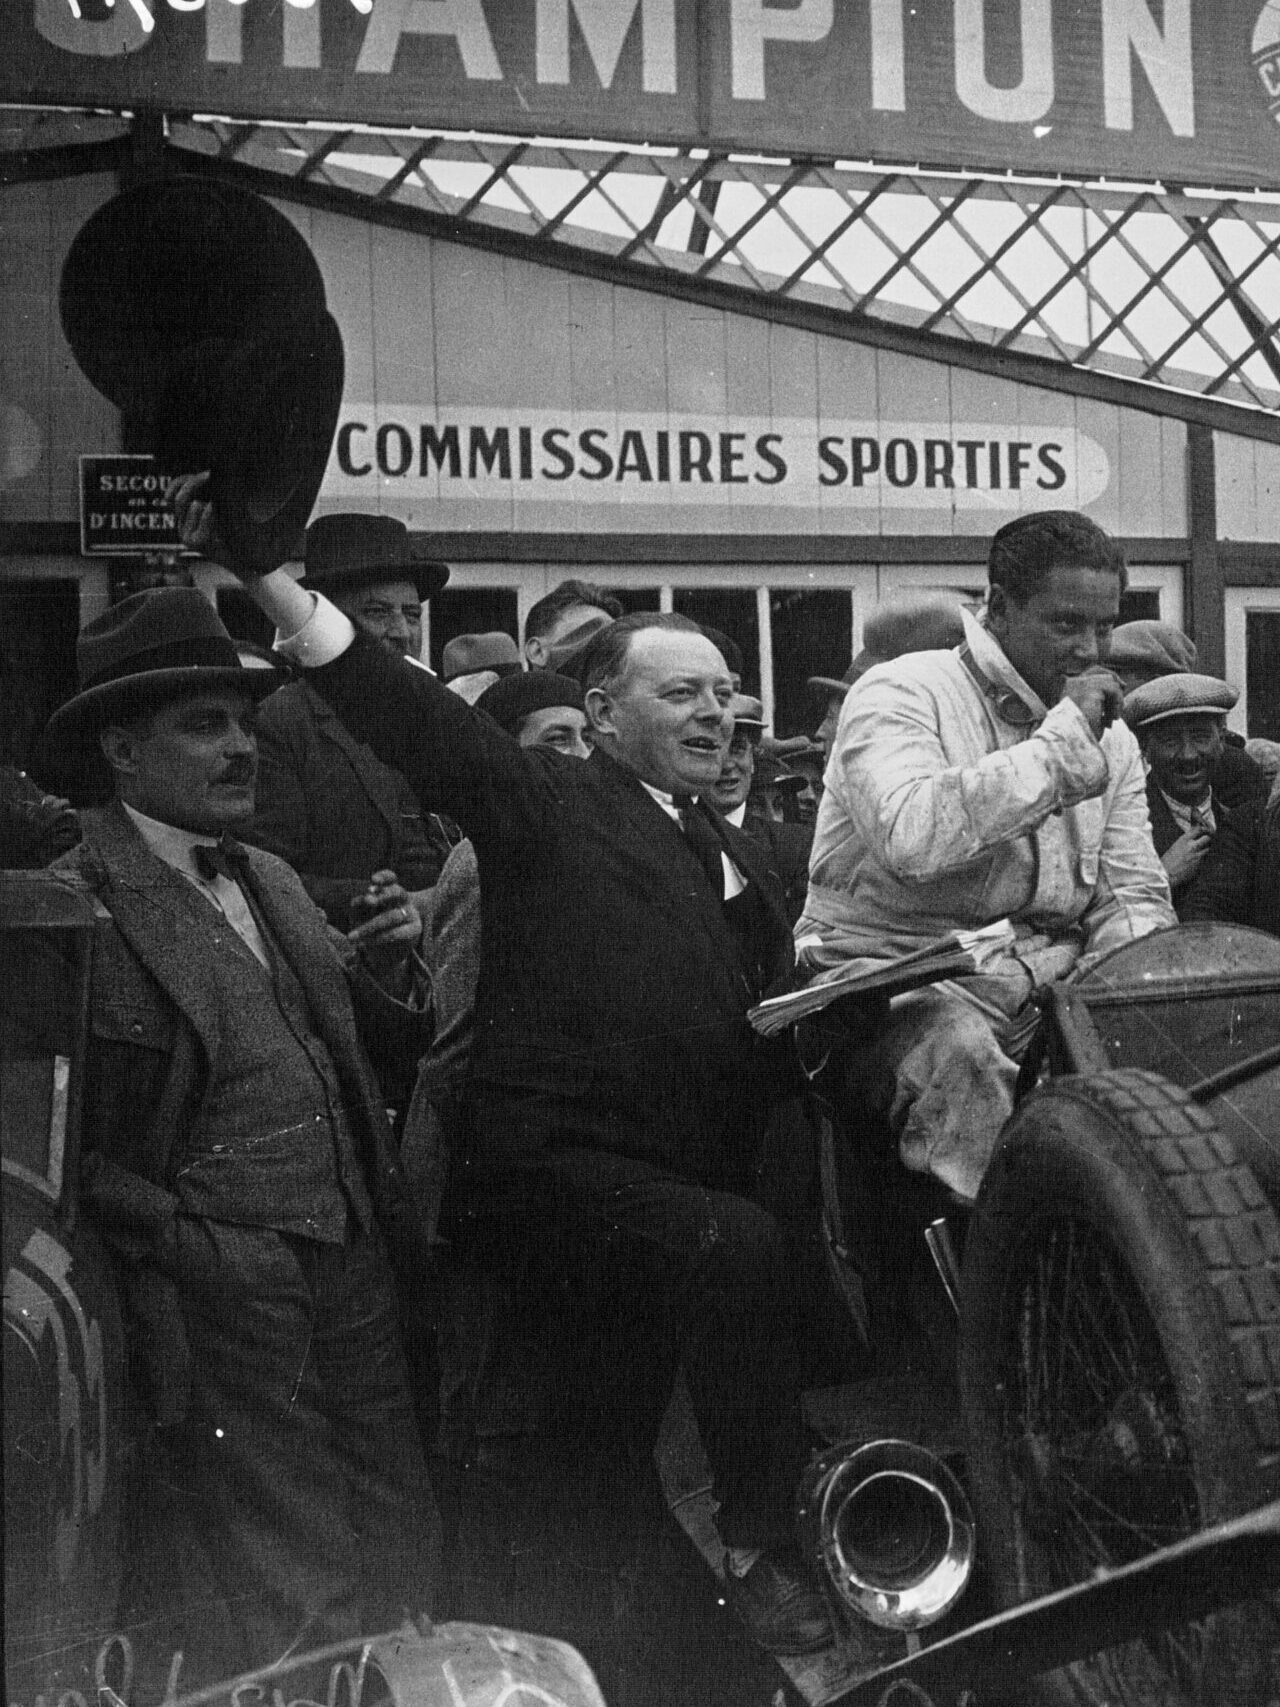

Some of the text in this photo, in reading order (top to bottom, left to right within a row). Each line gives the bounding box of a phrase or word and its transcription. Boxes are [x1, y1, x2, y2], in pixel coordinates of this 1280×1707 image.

[337, 422, 1067, 490] COMMISSAIRES SPORTIFS
[90, 512, 175, 530] D'INCEN
